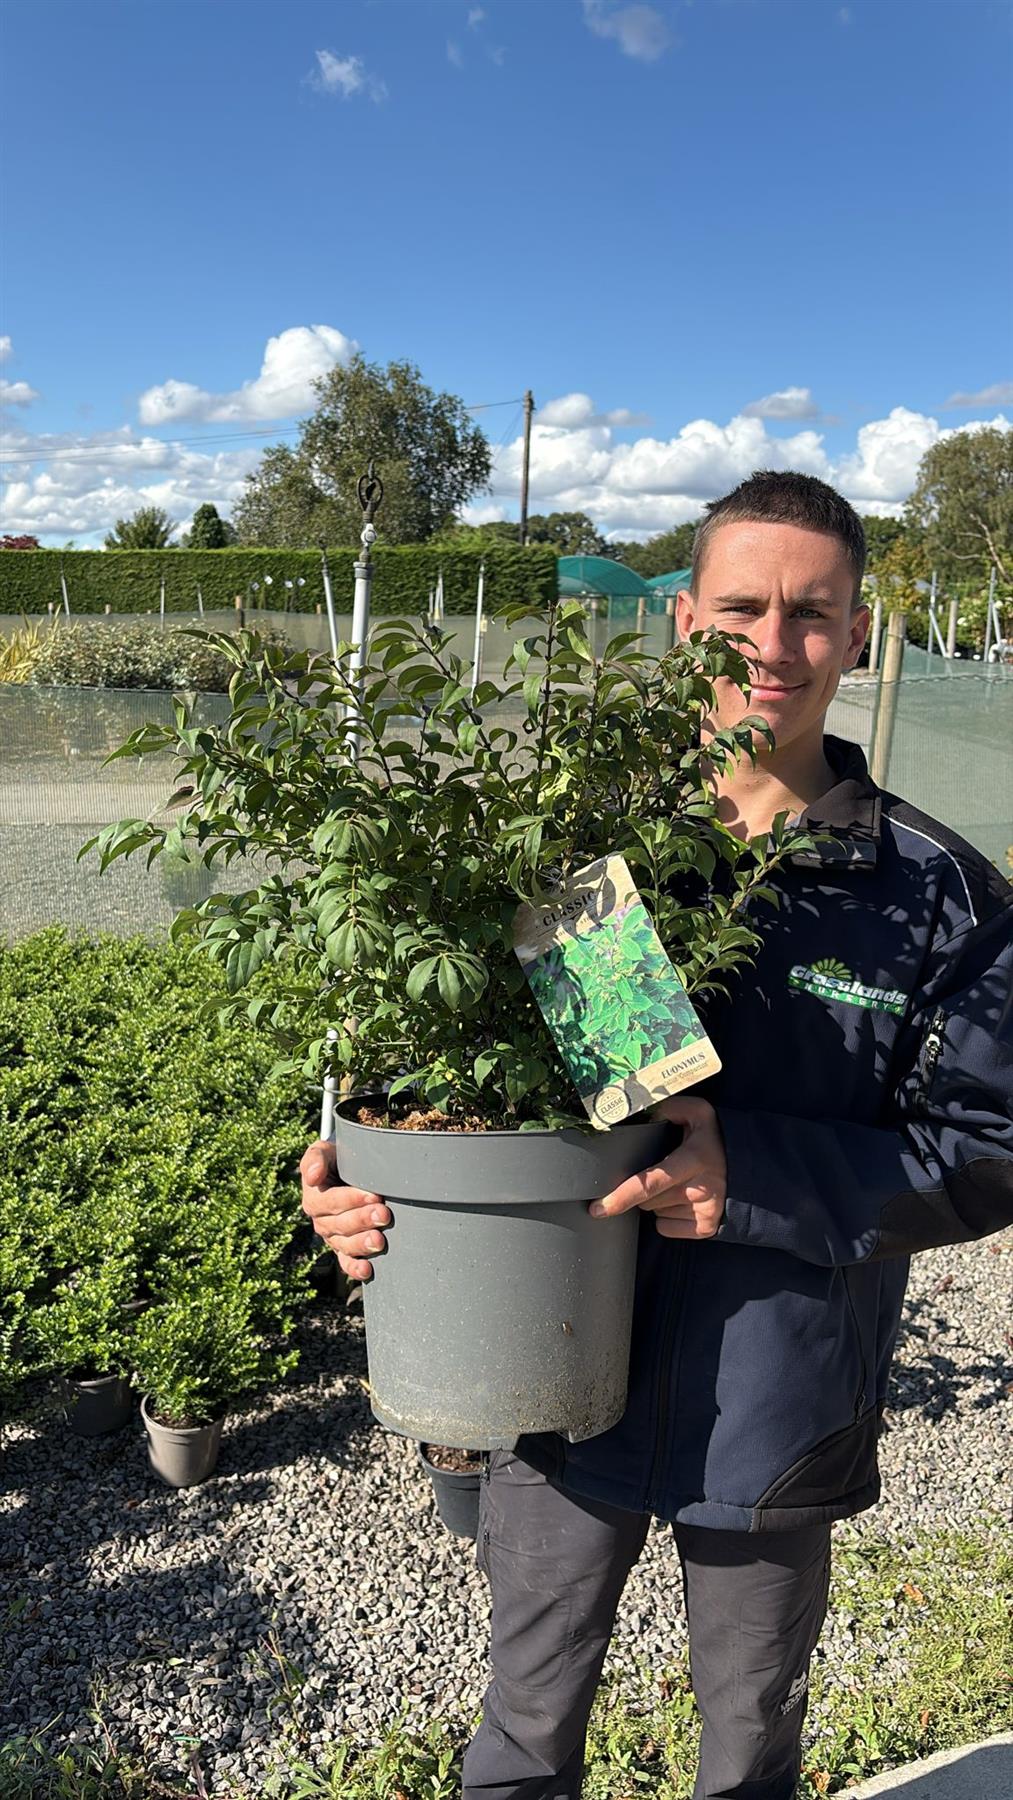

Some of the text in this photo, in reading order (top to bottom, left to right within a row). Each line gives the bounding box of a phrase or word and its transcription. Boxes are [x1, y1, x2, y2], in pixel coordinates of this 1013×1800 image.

[541, 889, 596, 927] CLASSIC
[790, 964, 909, 1005] Grasslands
[804, 982, 890, 1010] NURSERY
[660, 1051, 706, 1079] EUONYMUS
[600, 1096, 625, 1114] CLASSIC
